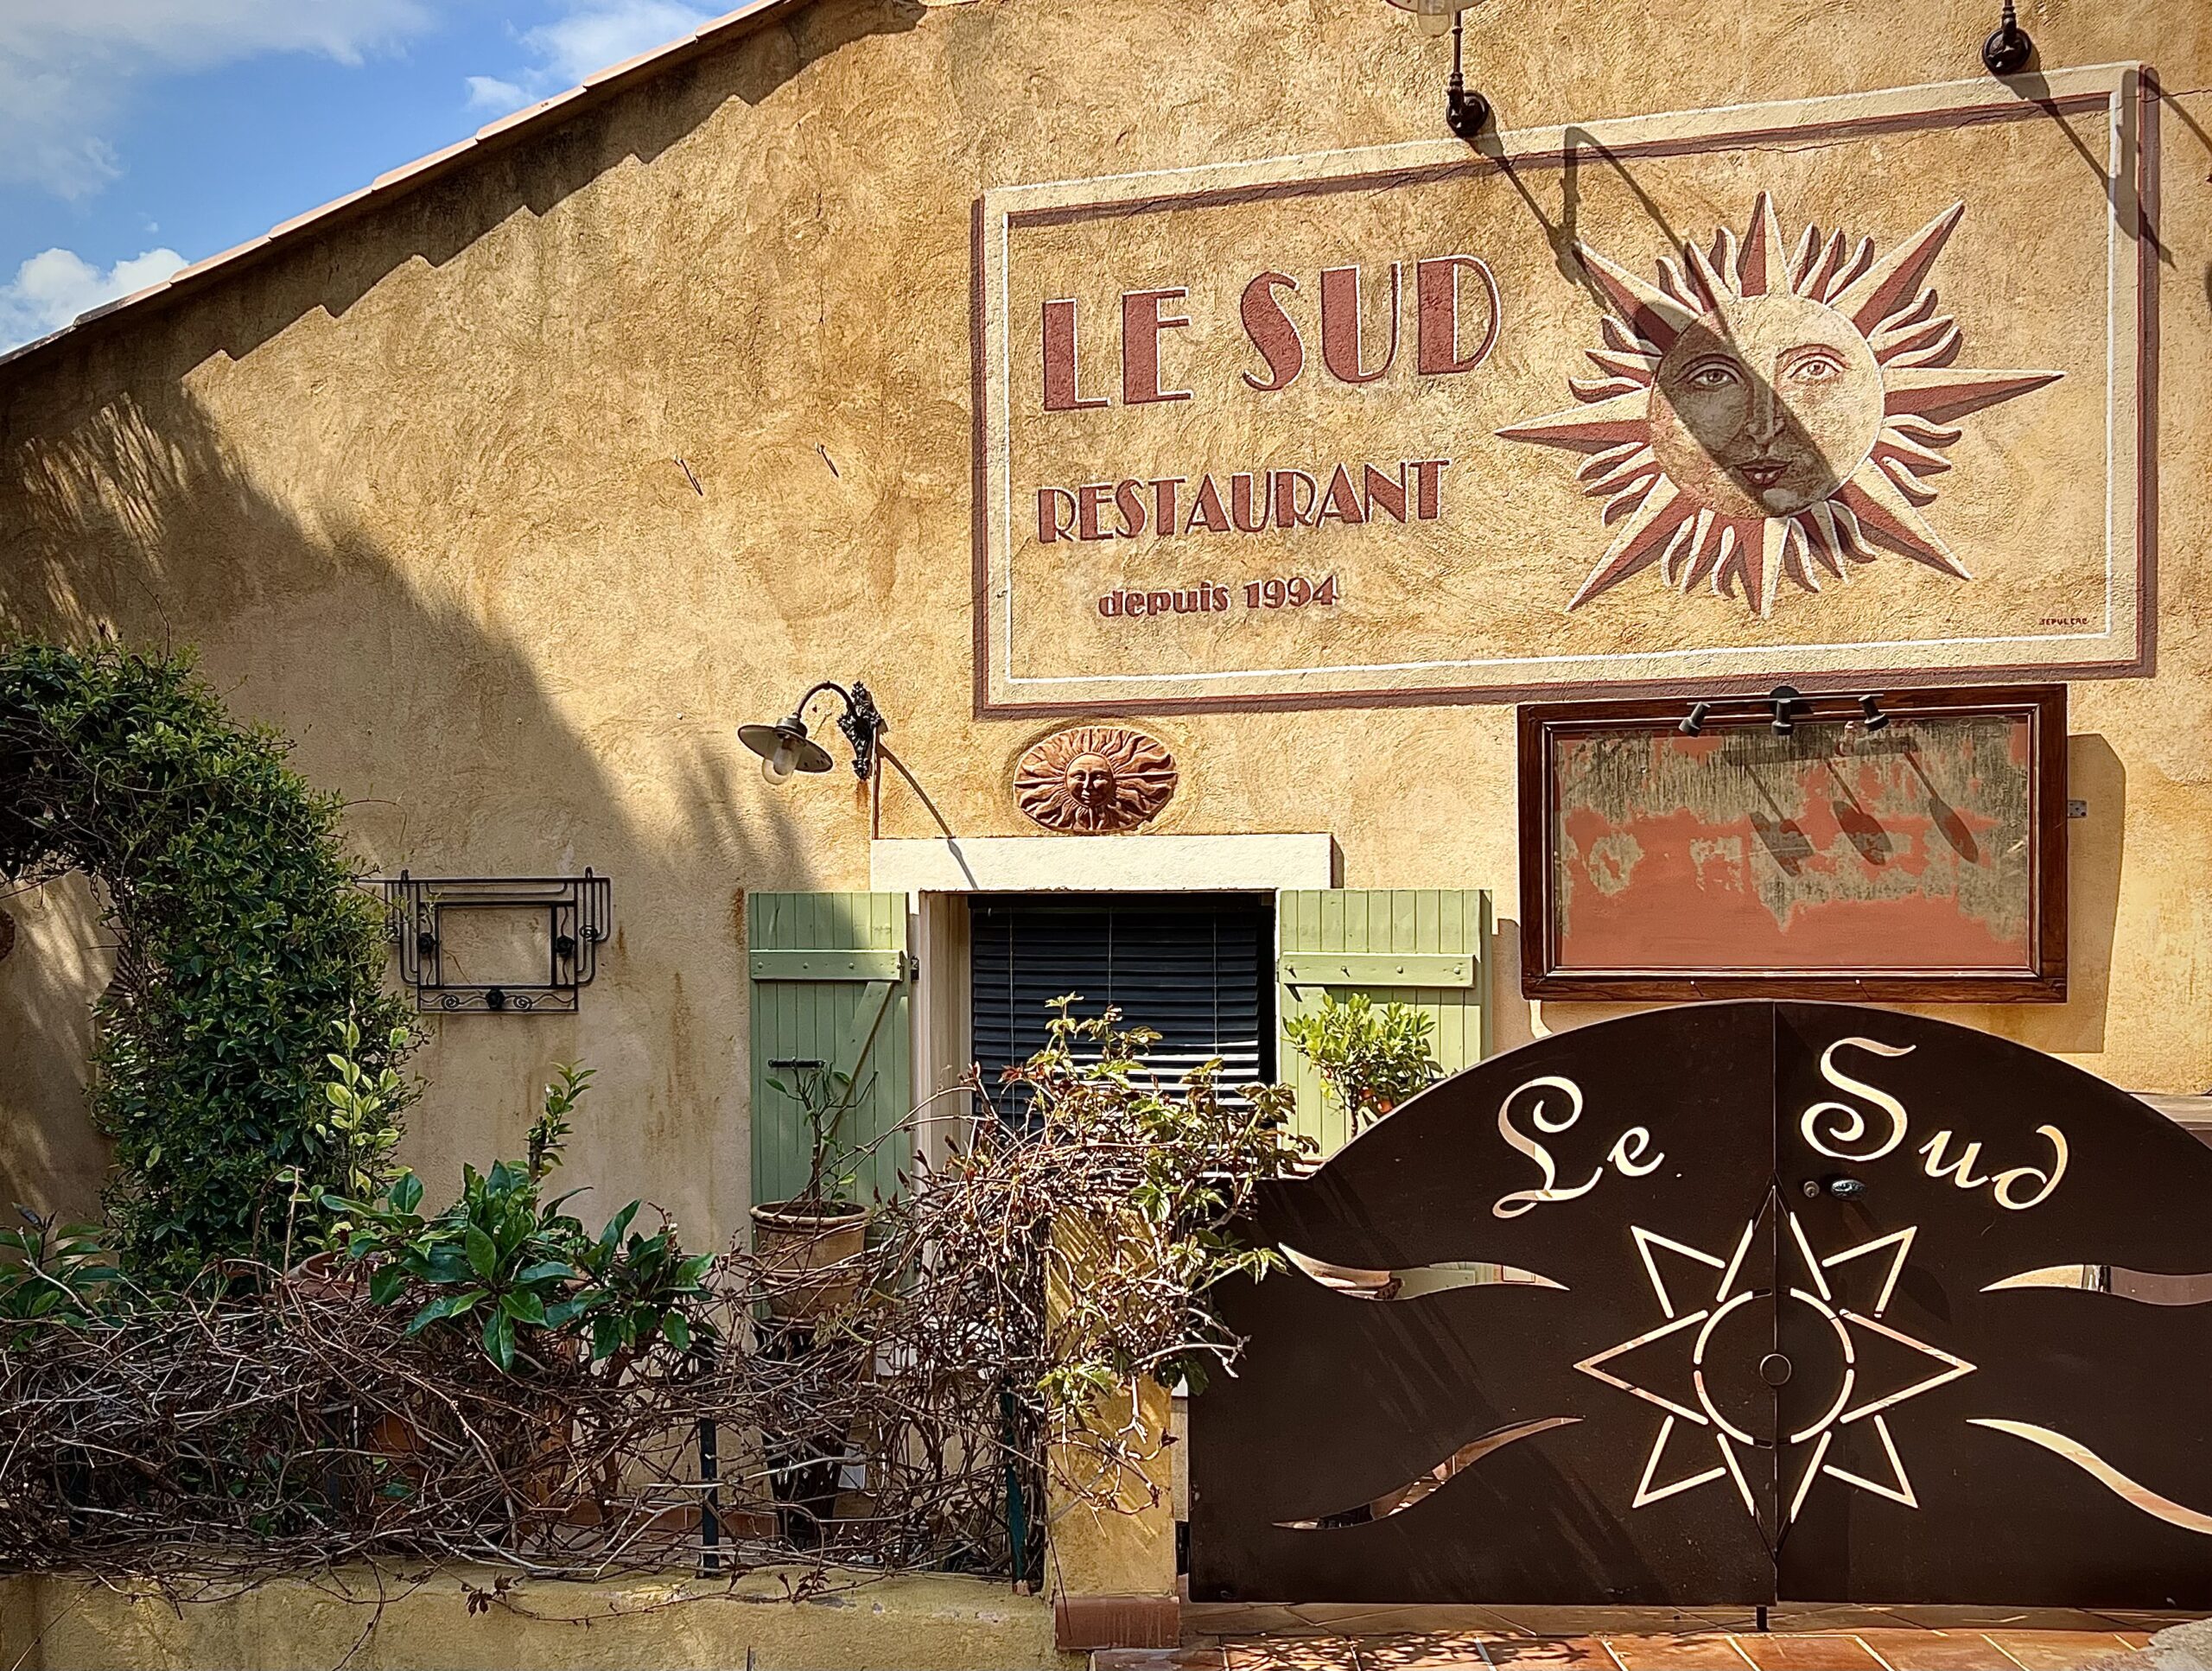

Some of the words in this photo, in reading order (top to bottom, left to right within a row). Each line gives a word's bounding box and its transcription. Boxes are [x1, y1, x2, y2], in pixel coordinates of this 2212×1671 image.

[1042, 286, 1194, 411] LE
[1240, 254, 1502, 392] SUD
[1037, 458, 1451, 543] RESTAURANT
[1098, 580, 1230, 618] depuis
[1243, 574, 1340, 609] 1994
[1492, 1075, 1665, 1219] Le
[1801, 1036, 2070, 1211] Sud
